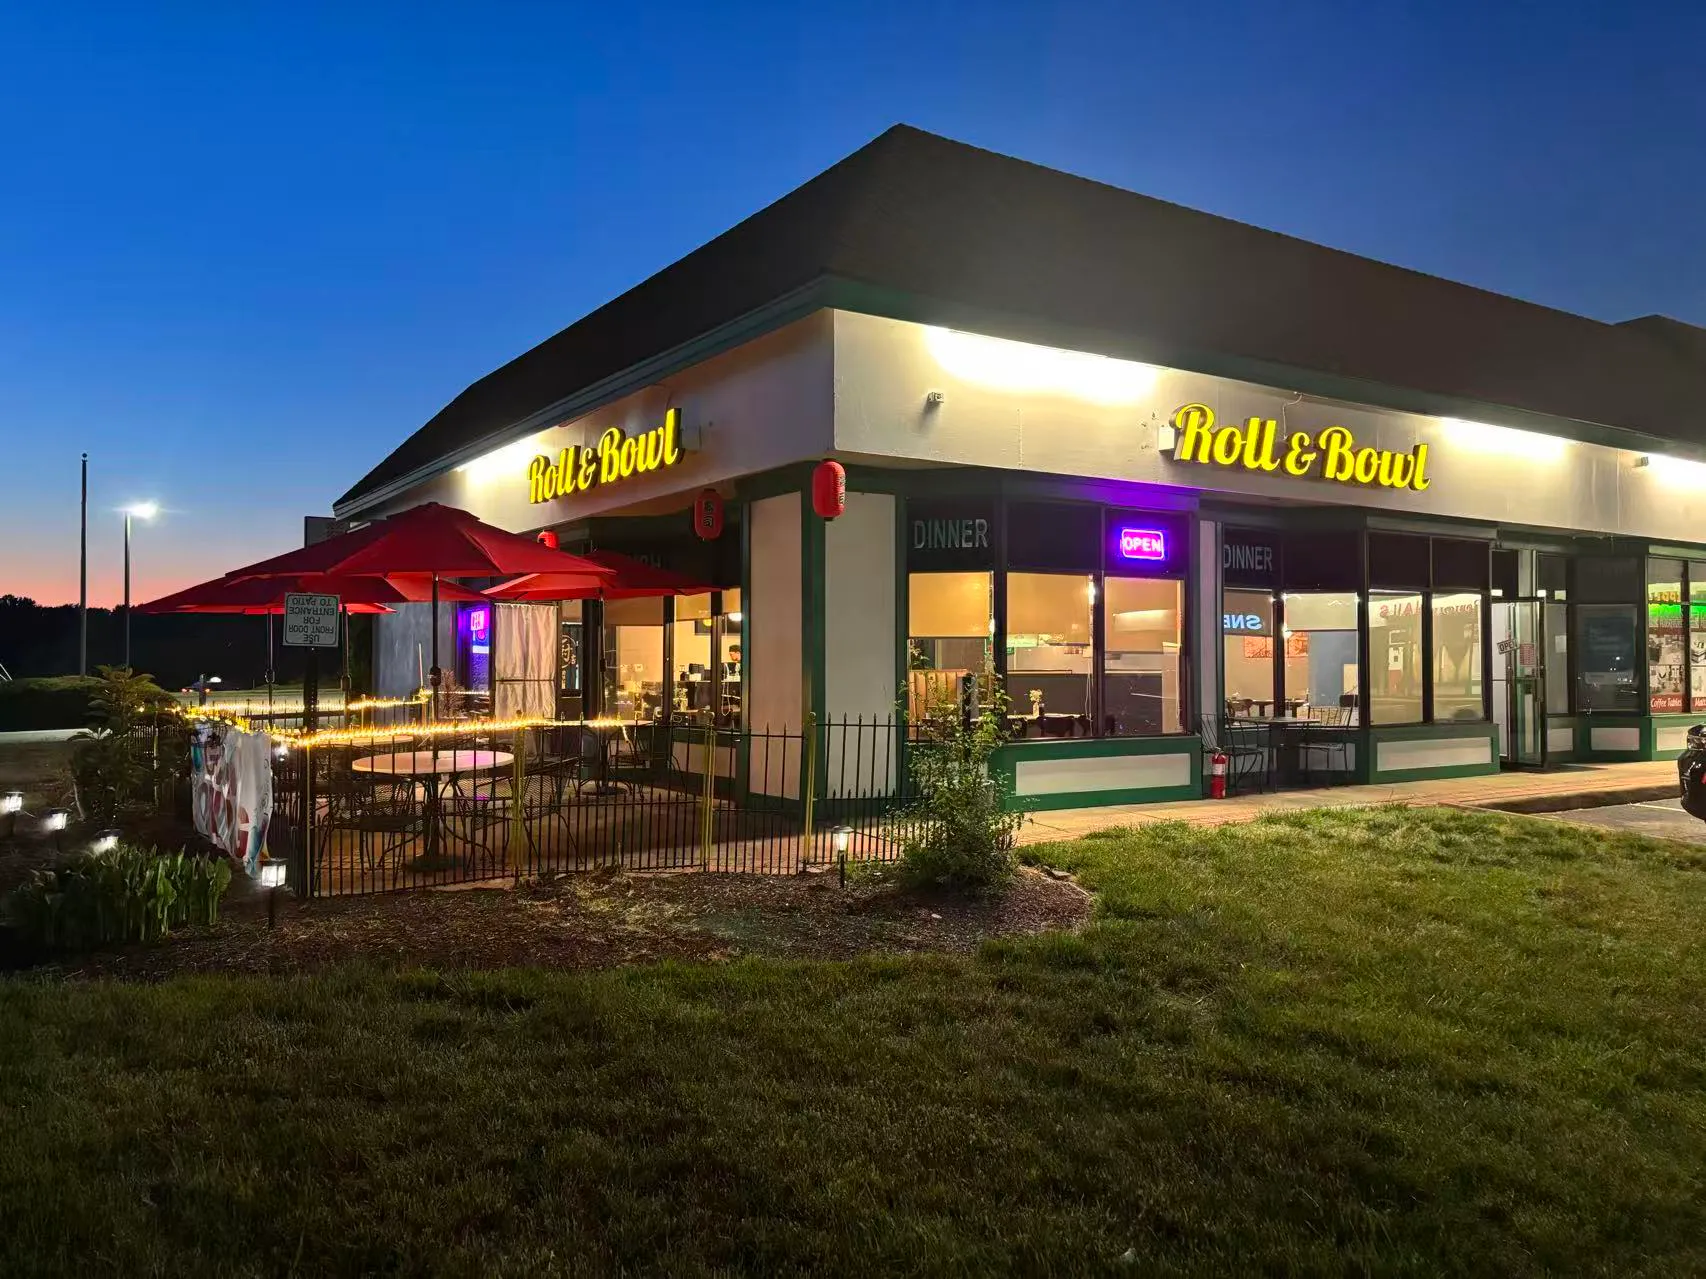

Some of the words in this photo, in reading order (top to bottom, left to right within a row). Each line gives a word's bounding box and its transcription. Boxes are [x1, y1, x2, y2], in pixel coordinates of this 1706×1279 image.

[1172, 403, 1280, 472] Roll
[1283, 431, 1317, 476] &
[1317, 425, 1431, 491] Bowl
[528, 445, 580, 504] Roll
[577, 447, 599, 491] &
[597, 407, 683, 485] Bowl
[913, 518, 989, 549] DINNER
[1122, 536, 1162, 552] OPEN
[1223, 543, 1273, 572] DINNER
[292, 597, 317, 606] PATIO
[289, 606, 335, 616] ENTRANCE
[303, 616, 321, 625] FOR
[288, 624, 309, 633] DOOR
[311, 625, 334, 634] FRONT
[303, 634, 320, 642] USE
